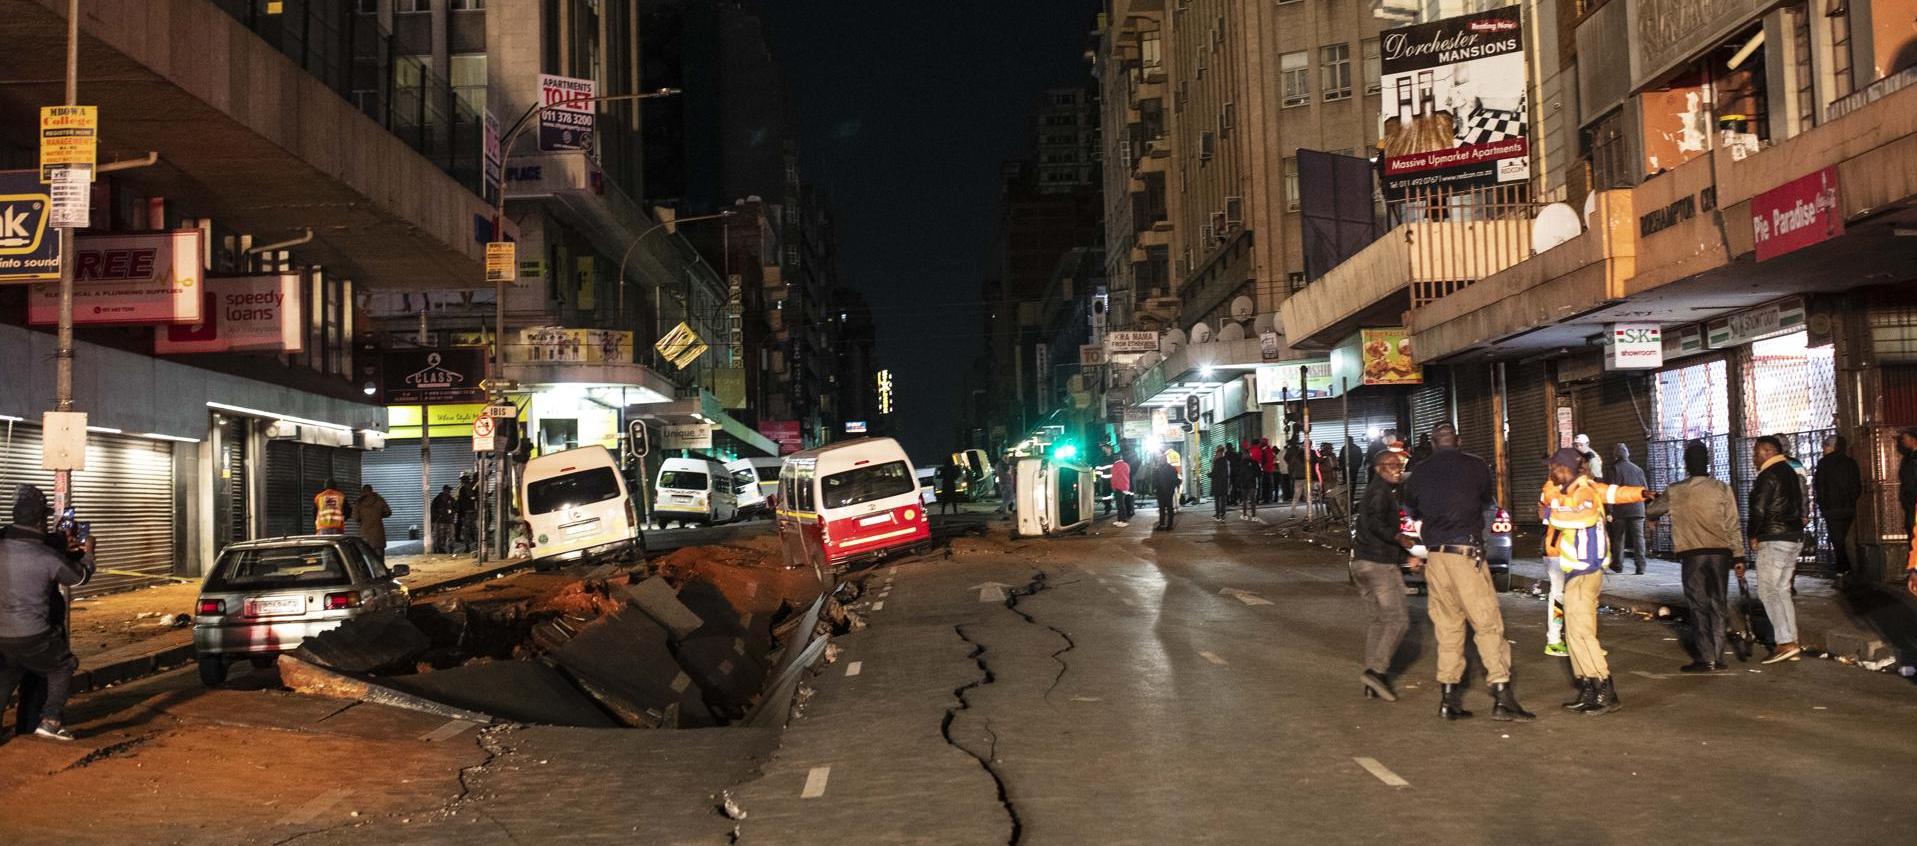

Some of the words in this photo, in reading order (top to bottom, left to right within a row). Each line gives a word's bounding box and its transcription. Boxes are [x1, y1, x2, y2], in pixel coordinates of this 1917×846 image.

[1471, 22, 1497, 31] Renting
[1497, 21, 1514, 30] Now
[1383, 29, 1478, 61] Dorchester
[1439, 38, 1517, 63] MANSIONS
[543, 78, 592, 92] APARTMENTS
[543, 87, 563, 105] TO
[566, 90, 591, 111] LET
[542, 110, 557, 122] 011
[557, 111, 572, 124] 378
[572, 113, 593, 127] 3200
[1391, 158, 1426, 170] Massive
[1428, 151, 1470, 167] Upmarket
[1471, 142, 1522, 160] Apartments
[1399, 179, 1410, 188] 011
[1411, 177, 1422, 186] 492
[1753, 214, 1770, 243] Pie
[1773, 199, 1816, 237] Paradise
[24, 255, 61, 267] sound
[225, 289, 284, 307] speedy
[226, 307, 274, 321] loans
[1620, 348, 1658, 358] showroom
[415, 372, 453, 384] CLASS
[490, 407, 507, 416] IBIS
[664, 428, 695, 439] Unique
